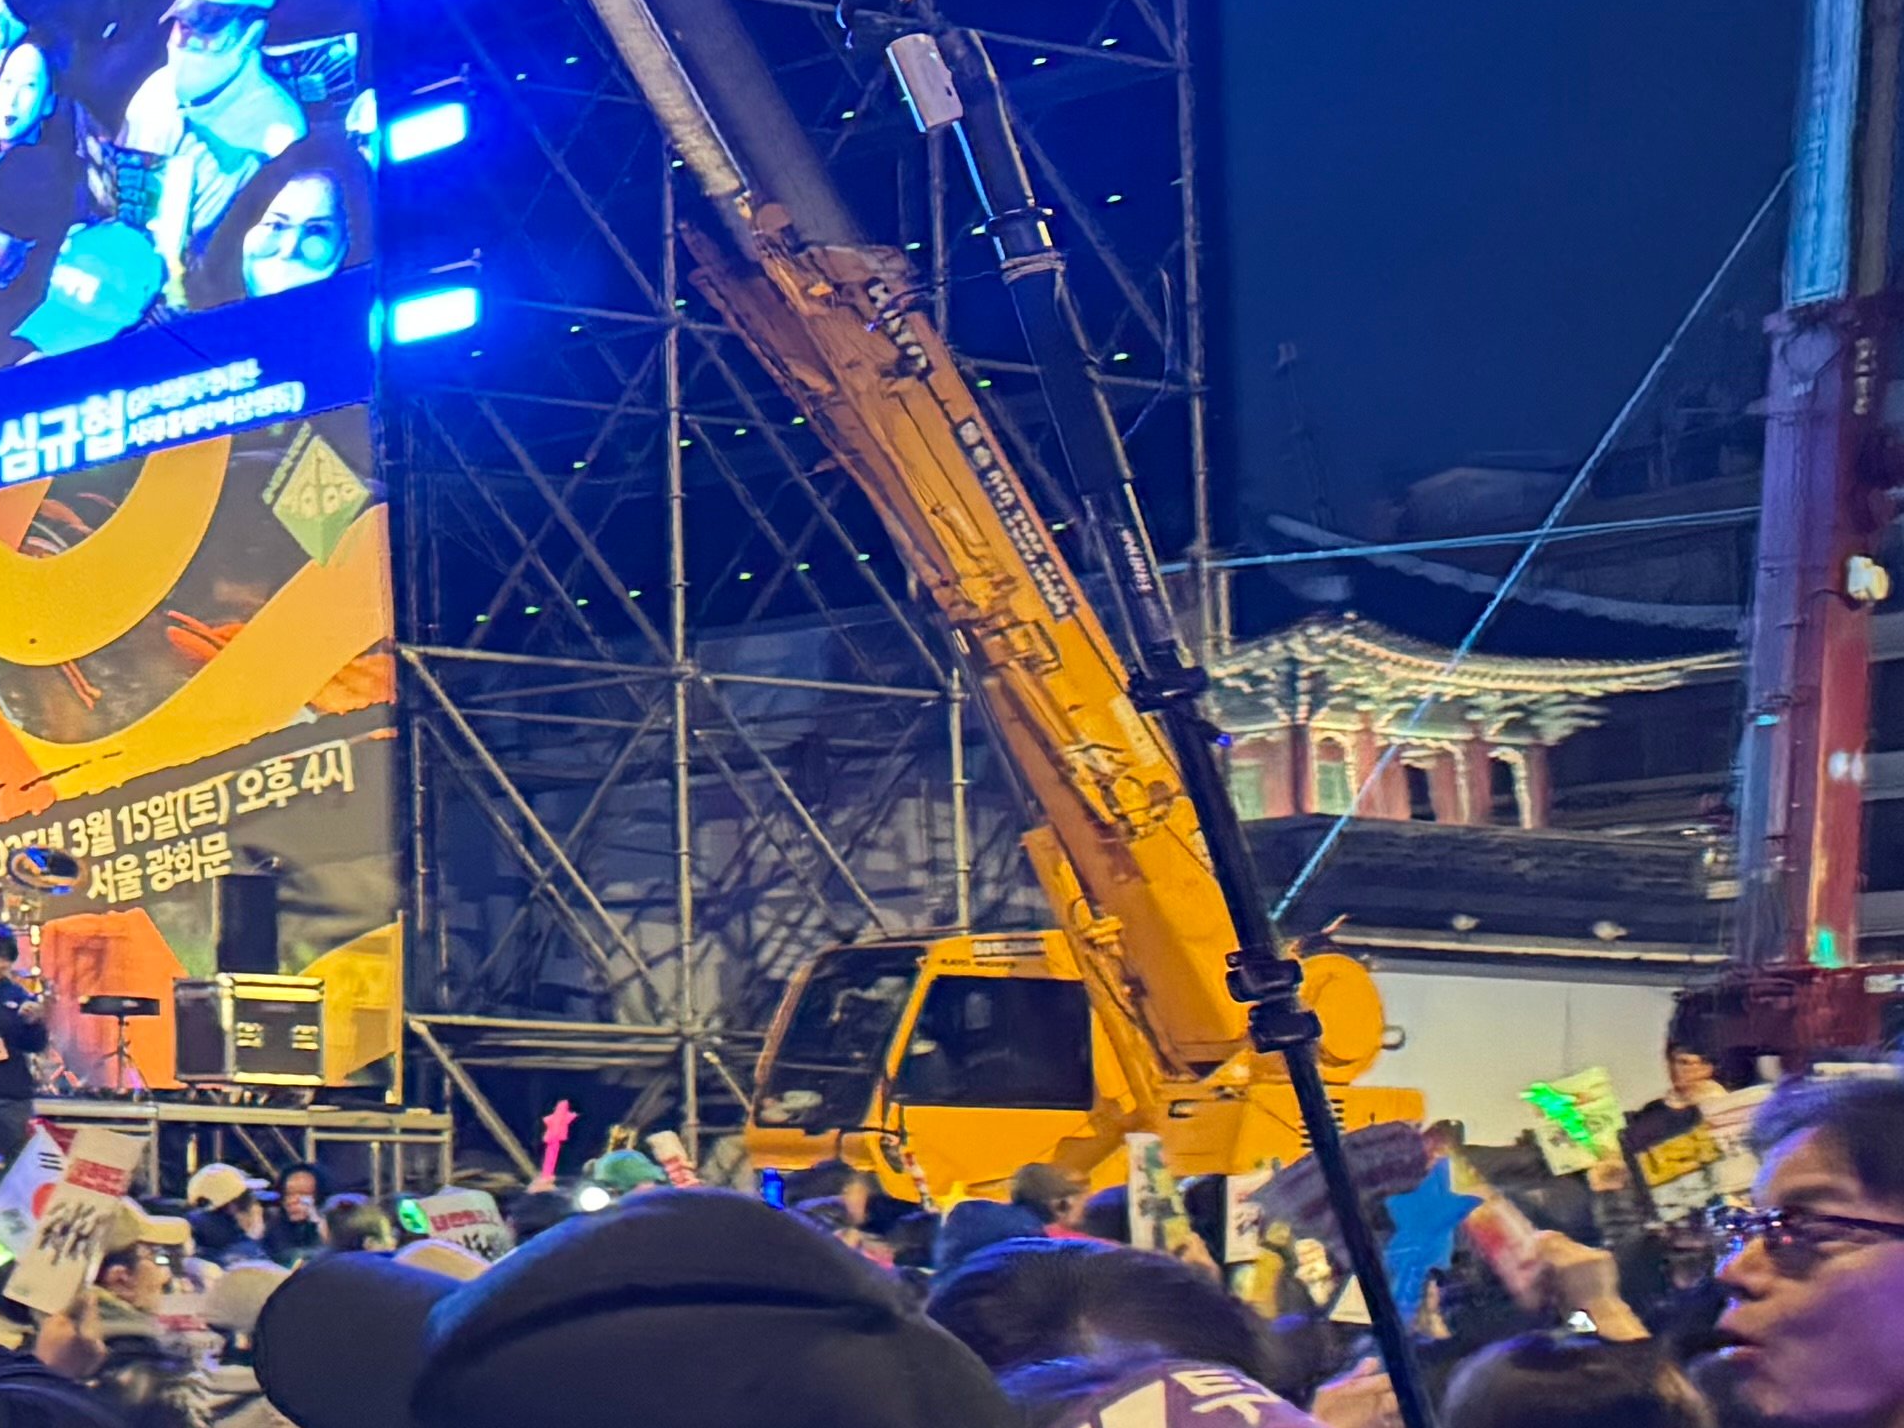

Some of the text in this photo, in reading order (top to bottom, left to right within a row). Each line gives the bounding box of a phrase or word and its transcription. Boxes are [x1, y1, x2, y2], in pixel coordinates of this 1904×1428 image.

[68, 808, 116, 857] 3월
[116, 780, 231, 845] 15일(토)
[236, 759, 298, 816] 오후
[299, 740, 355, 795] 4시
[87, 831, 233, 904] 서울 광화문
